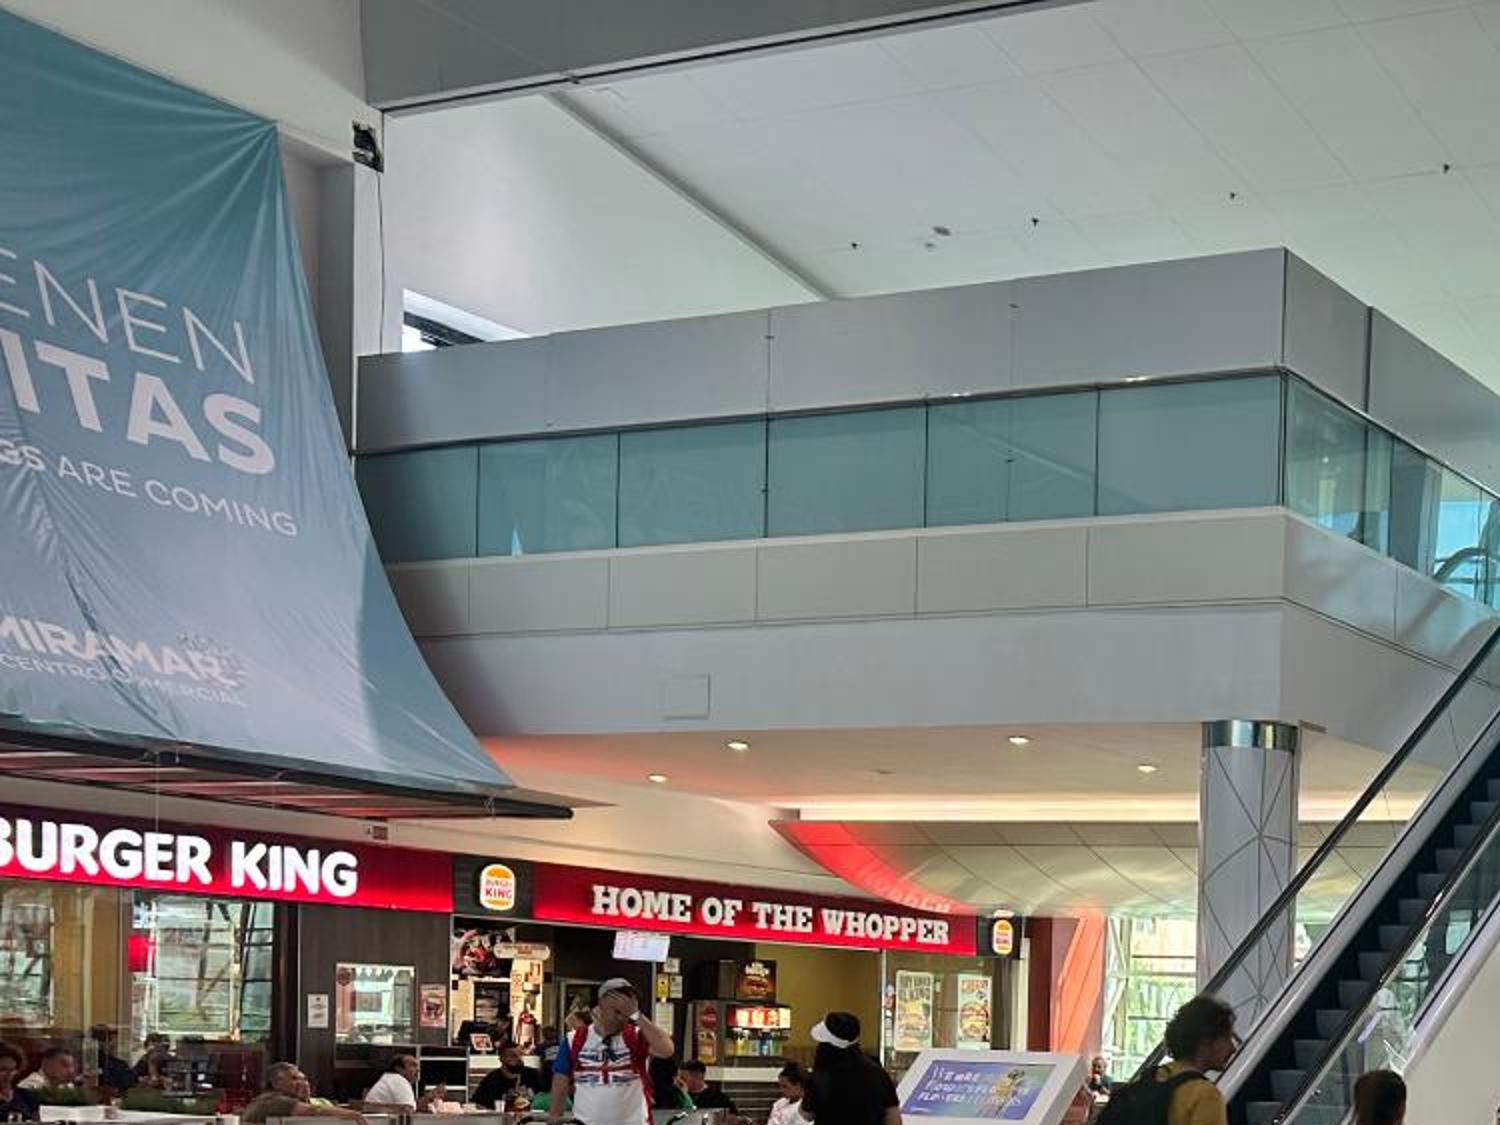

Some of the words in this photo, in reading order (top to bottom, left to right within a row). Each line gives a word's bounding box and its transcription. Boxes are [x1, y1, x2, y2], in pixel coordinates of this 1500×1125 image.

[58, 455, 137, 498] ARE
[144, 479, 298, 536] COMING
[231, 840, 358, 898] KING
[484, 887, 513, 899] KING
[591, 884, 692, 923] HOME
[702, 896, 743, 928] OF
[752, 901, 813, 932] THE
[820, 907, 949, 946] WHOPPER
